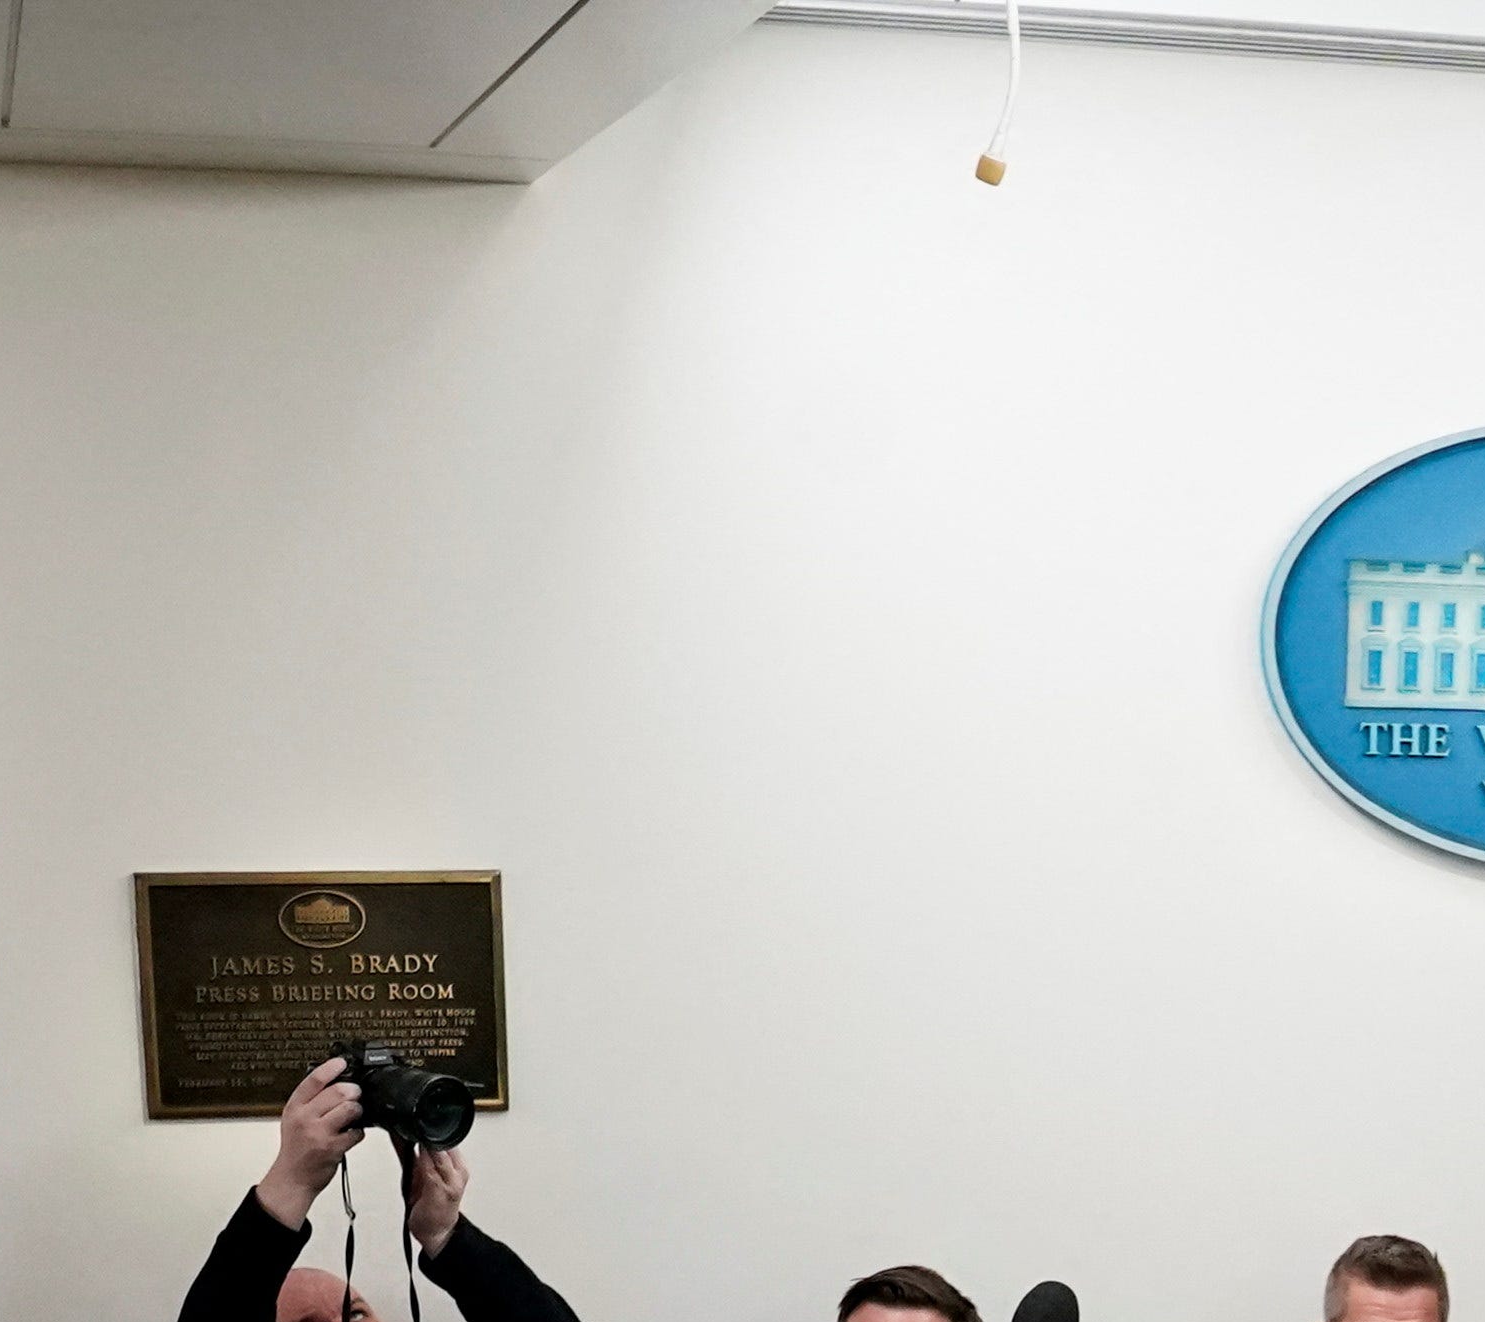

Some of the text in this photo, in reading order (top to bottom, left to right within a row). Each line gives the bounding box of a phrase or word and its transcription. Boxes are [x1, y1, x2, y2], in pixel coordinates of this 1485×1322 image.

[1359, 720, 1451, 760] THE
[210, 952, 440, 980] JAMES S. BRADY
[195, 982, 455, 1004] PRESS BRIEFING ROOM
